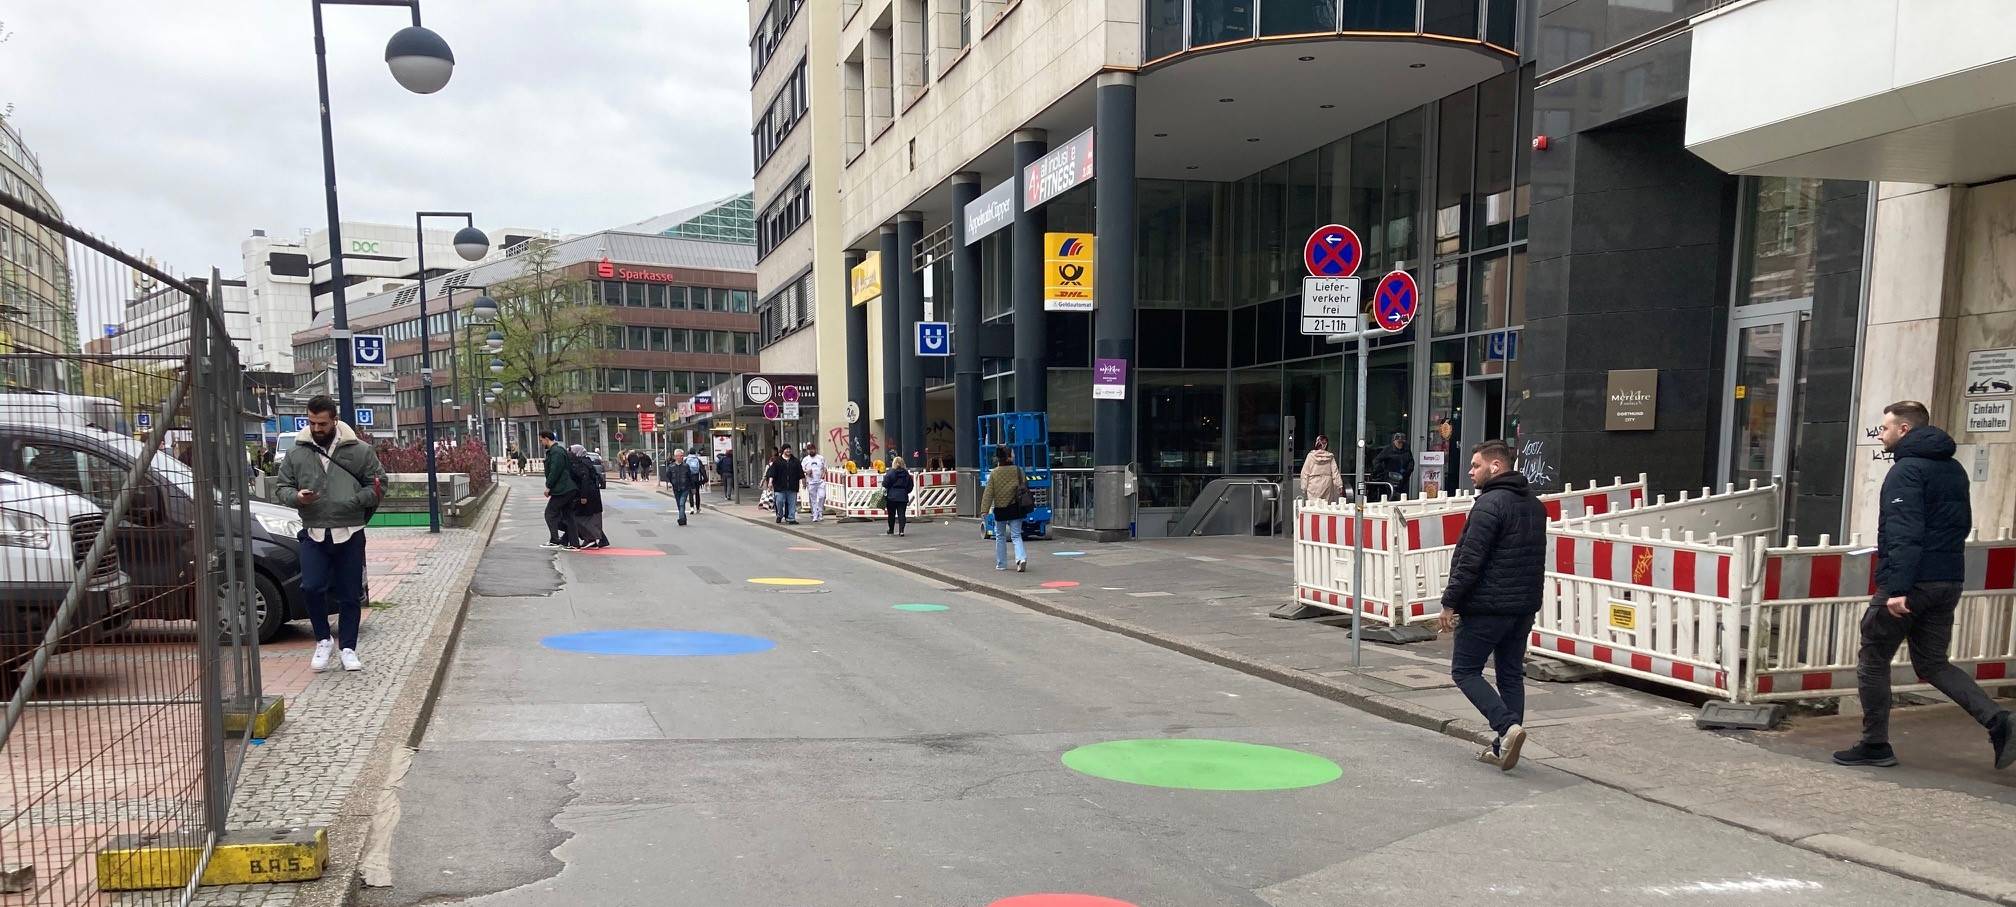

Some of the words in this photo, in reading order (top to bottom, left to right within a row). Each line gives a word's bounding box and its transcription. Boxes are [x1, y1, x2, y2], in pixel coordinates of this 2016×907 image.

[1040, 161, 1075, 201] FITNESS
[352, 240, 379, 254] DOC
[619, 268, 673, 282] Sparkasse
[1315, 282, 1349, 291] Liefer-
[1312, 294, 1351, 302] verkehr
[1058, 301, 1091, 309] Geldautomat
[1322, 305, 1340, 314] frei
[1314, 320, 1346, 331] 21-11h
[925, 328, 942, 349] U
[359, 340, 379, 361] U
[1611, 388, 1651, 406] Mercure
[1973, 403, 2005, 414] Einfahrt
[1970, 418, 2007, 428] freihalten
